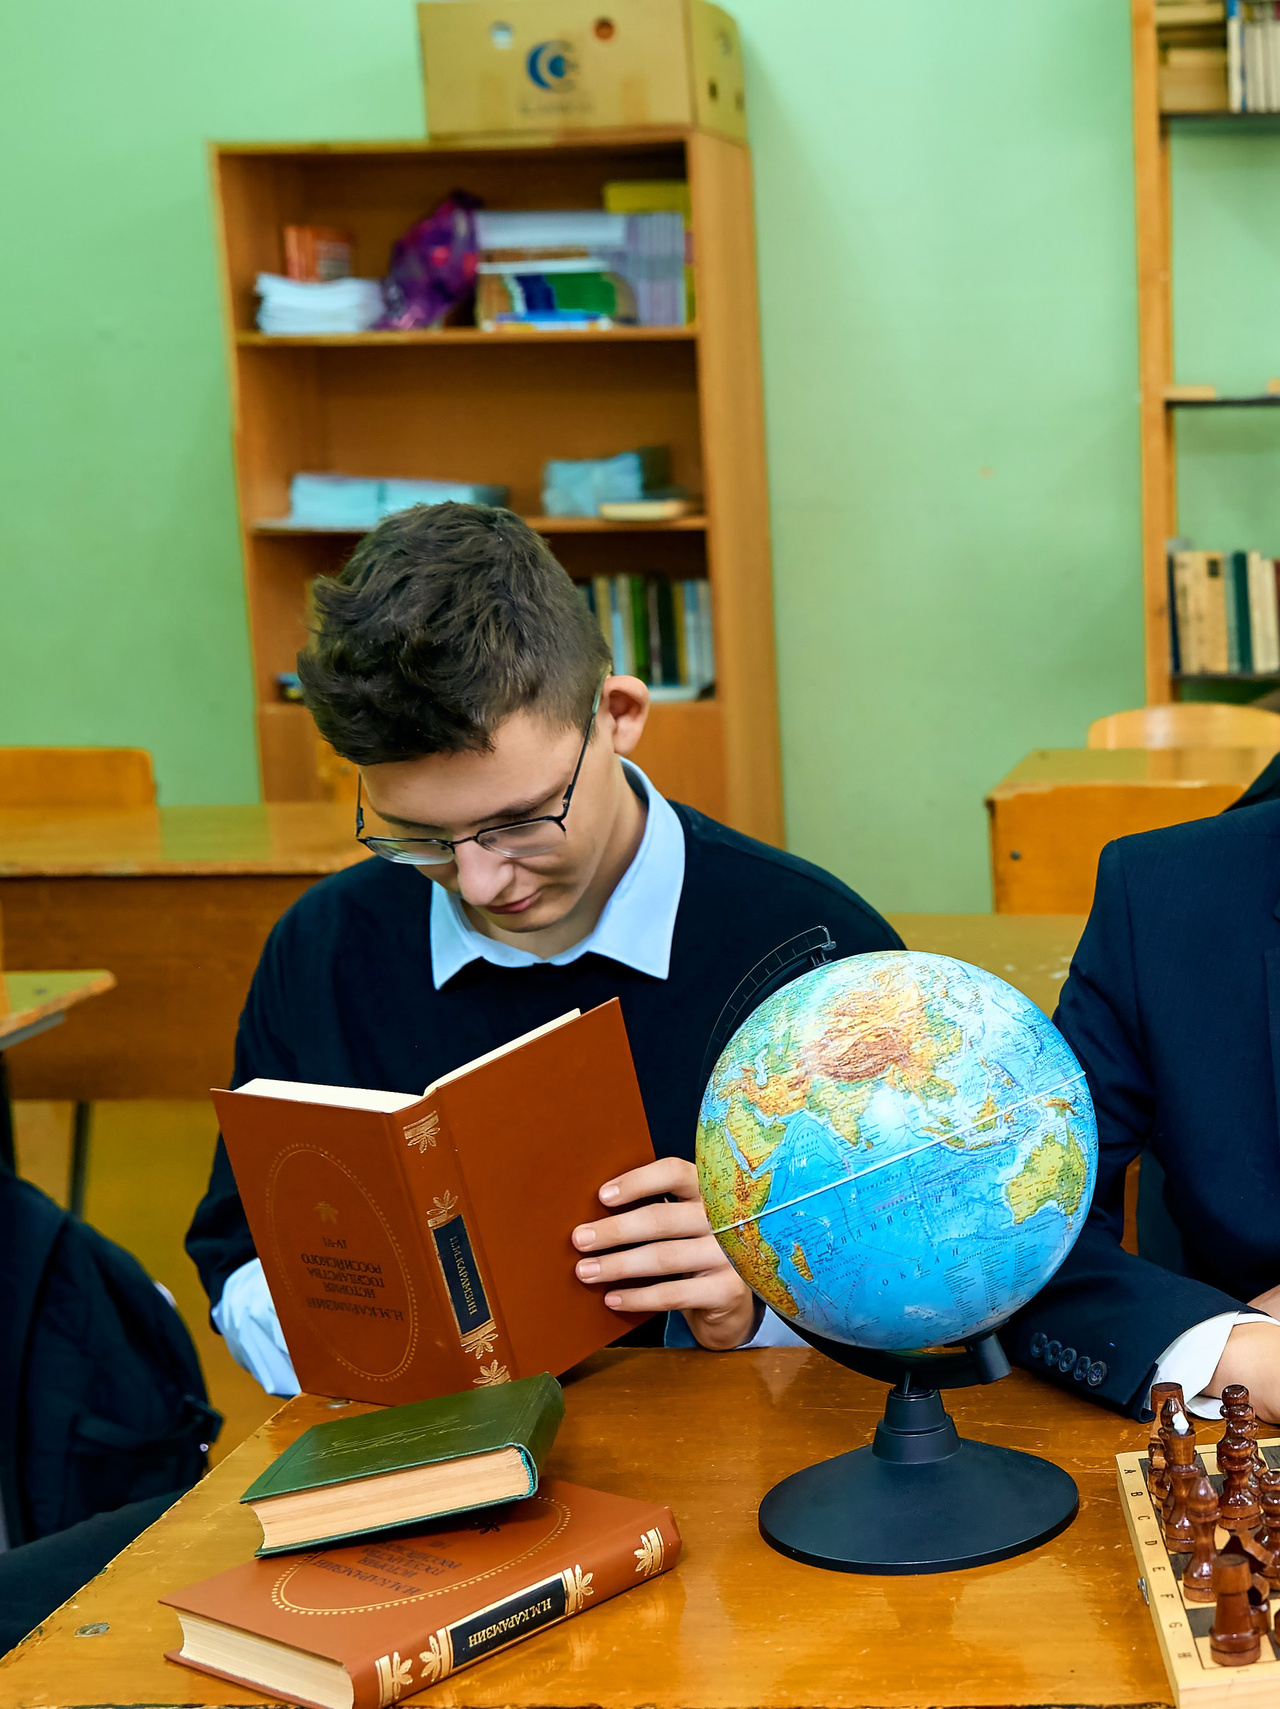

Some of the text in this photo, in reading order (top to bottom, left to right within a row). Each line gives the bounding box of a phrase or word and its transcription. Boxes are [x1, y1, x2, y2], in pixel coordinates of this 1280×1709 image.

[301, 1253, 382, 1274] РОССИЙСКОГО
[306, 1266, 385, 1288] ГОСУДАРСТВА
[322, 1282, 376, 1299] ИСТОРИЯ
